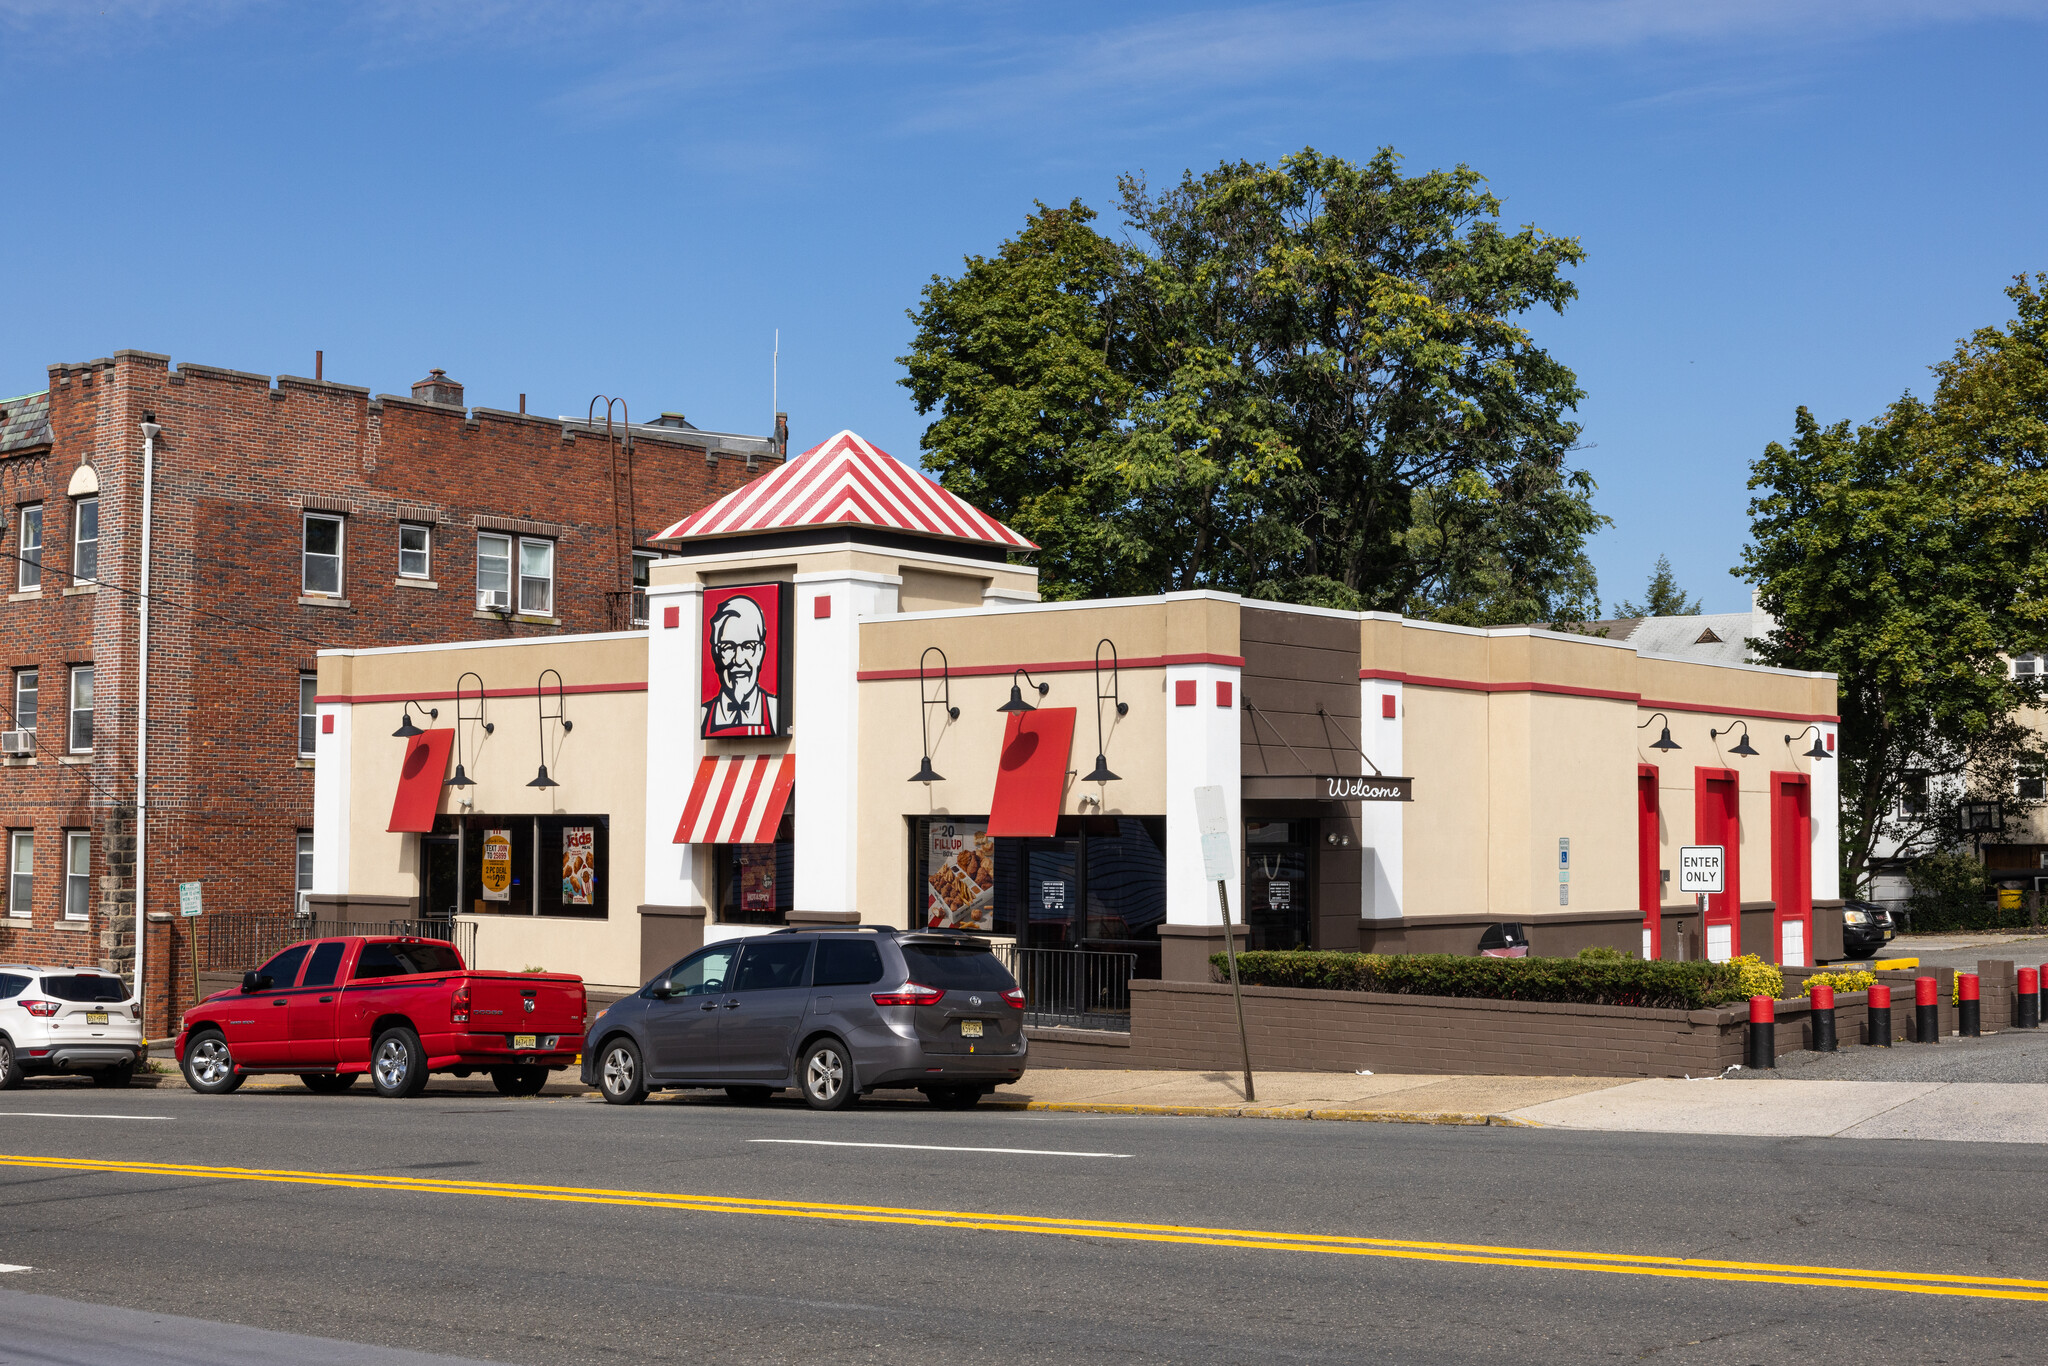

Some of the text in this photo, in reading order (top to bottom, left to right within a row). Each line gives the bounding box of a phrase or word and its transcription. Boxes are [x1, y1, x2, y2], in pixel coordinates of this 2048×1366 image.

[1326, 777, 1401, 798] Welcome
[567, 832, 592, 848] kids
[934, 838, 962, 850] FILL UP
[486, 844, 508, 852] TEXT JOIN
[487, 852, 493, 860] TO
[942, 850, 953, 858] BOX
[1684, 857, 1719, 867] ENTER
[1686, 871, 1716, 882] ONLY
